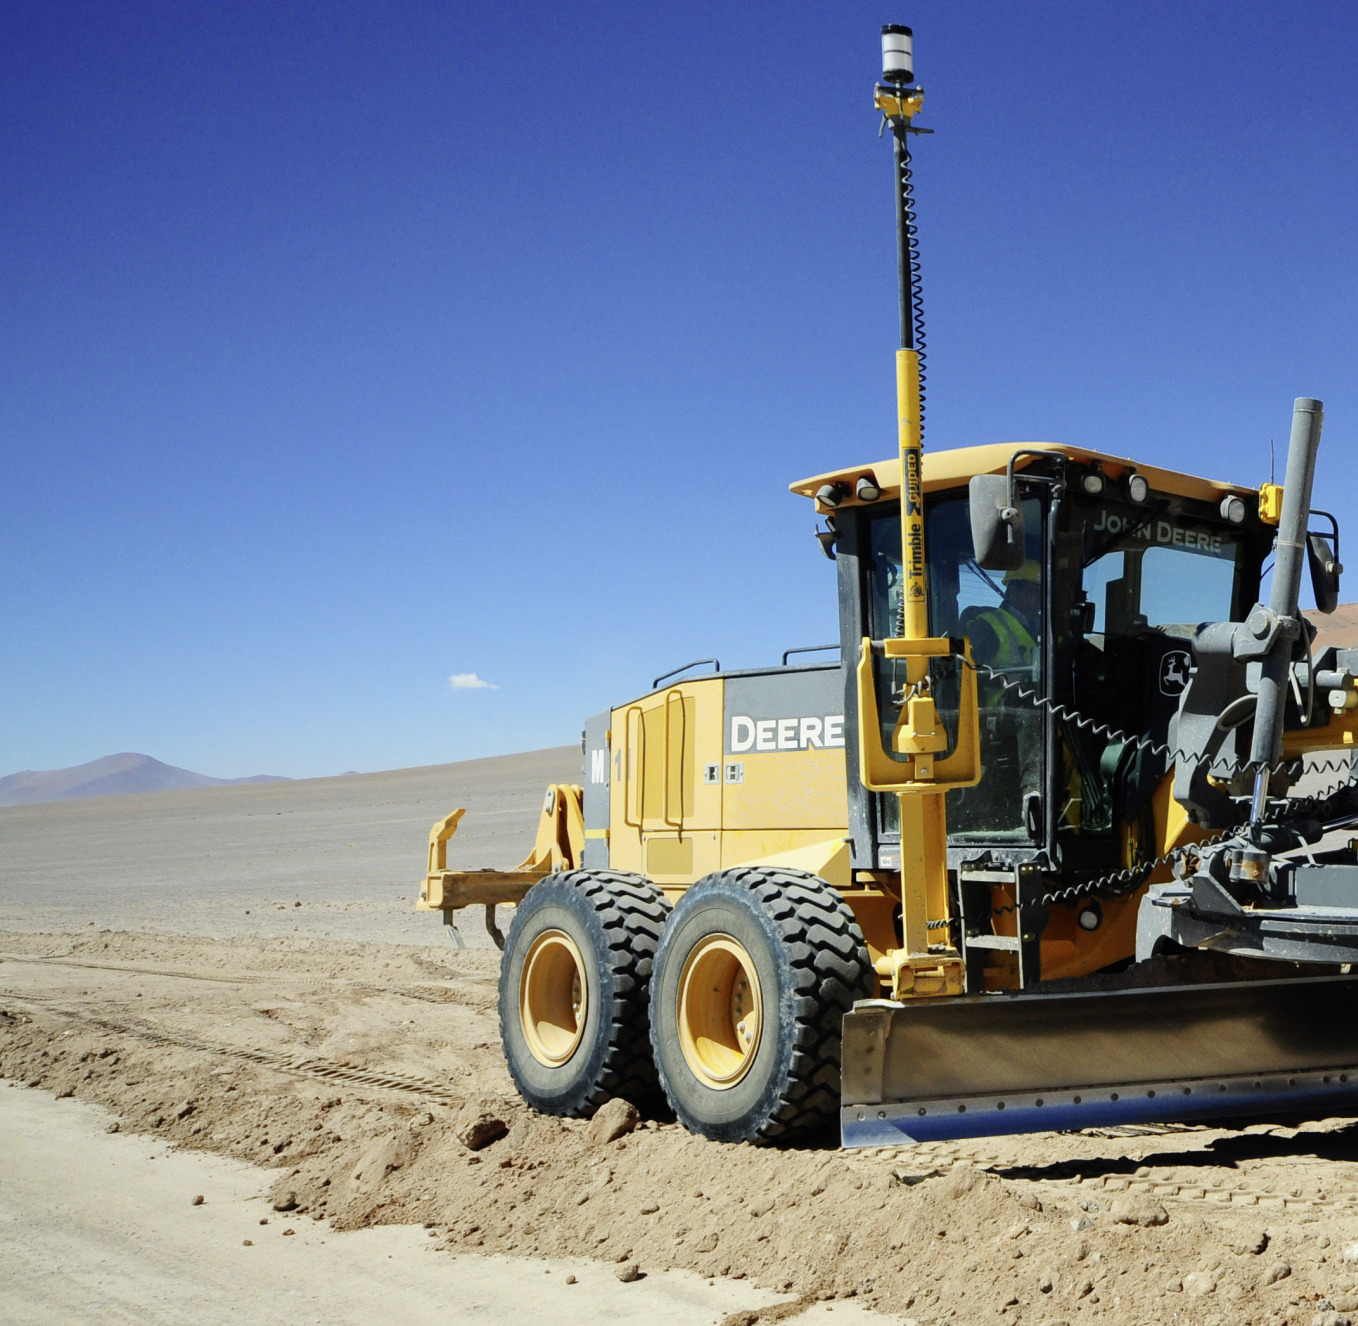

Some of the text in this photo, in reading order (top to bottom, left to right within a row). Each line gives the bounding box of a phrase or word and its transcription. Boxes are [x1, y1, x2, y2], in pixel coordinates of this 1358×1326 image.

[907, 454, 922, 579] Trimble GUIDED
[1157, 521, 1221, 554] DEERE
[731, 715, 845, 752] DEERE
